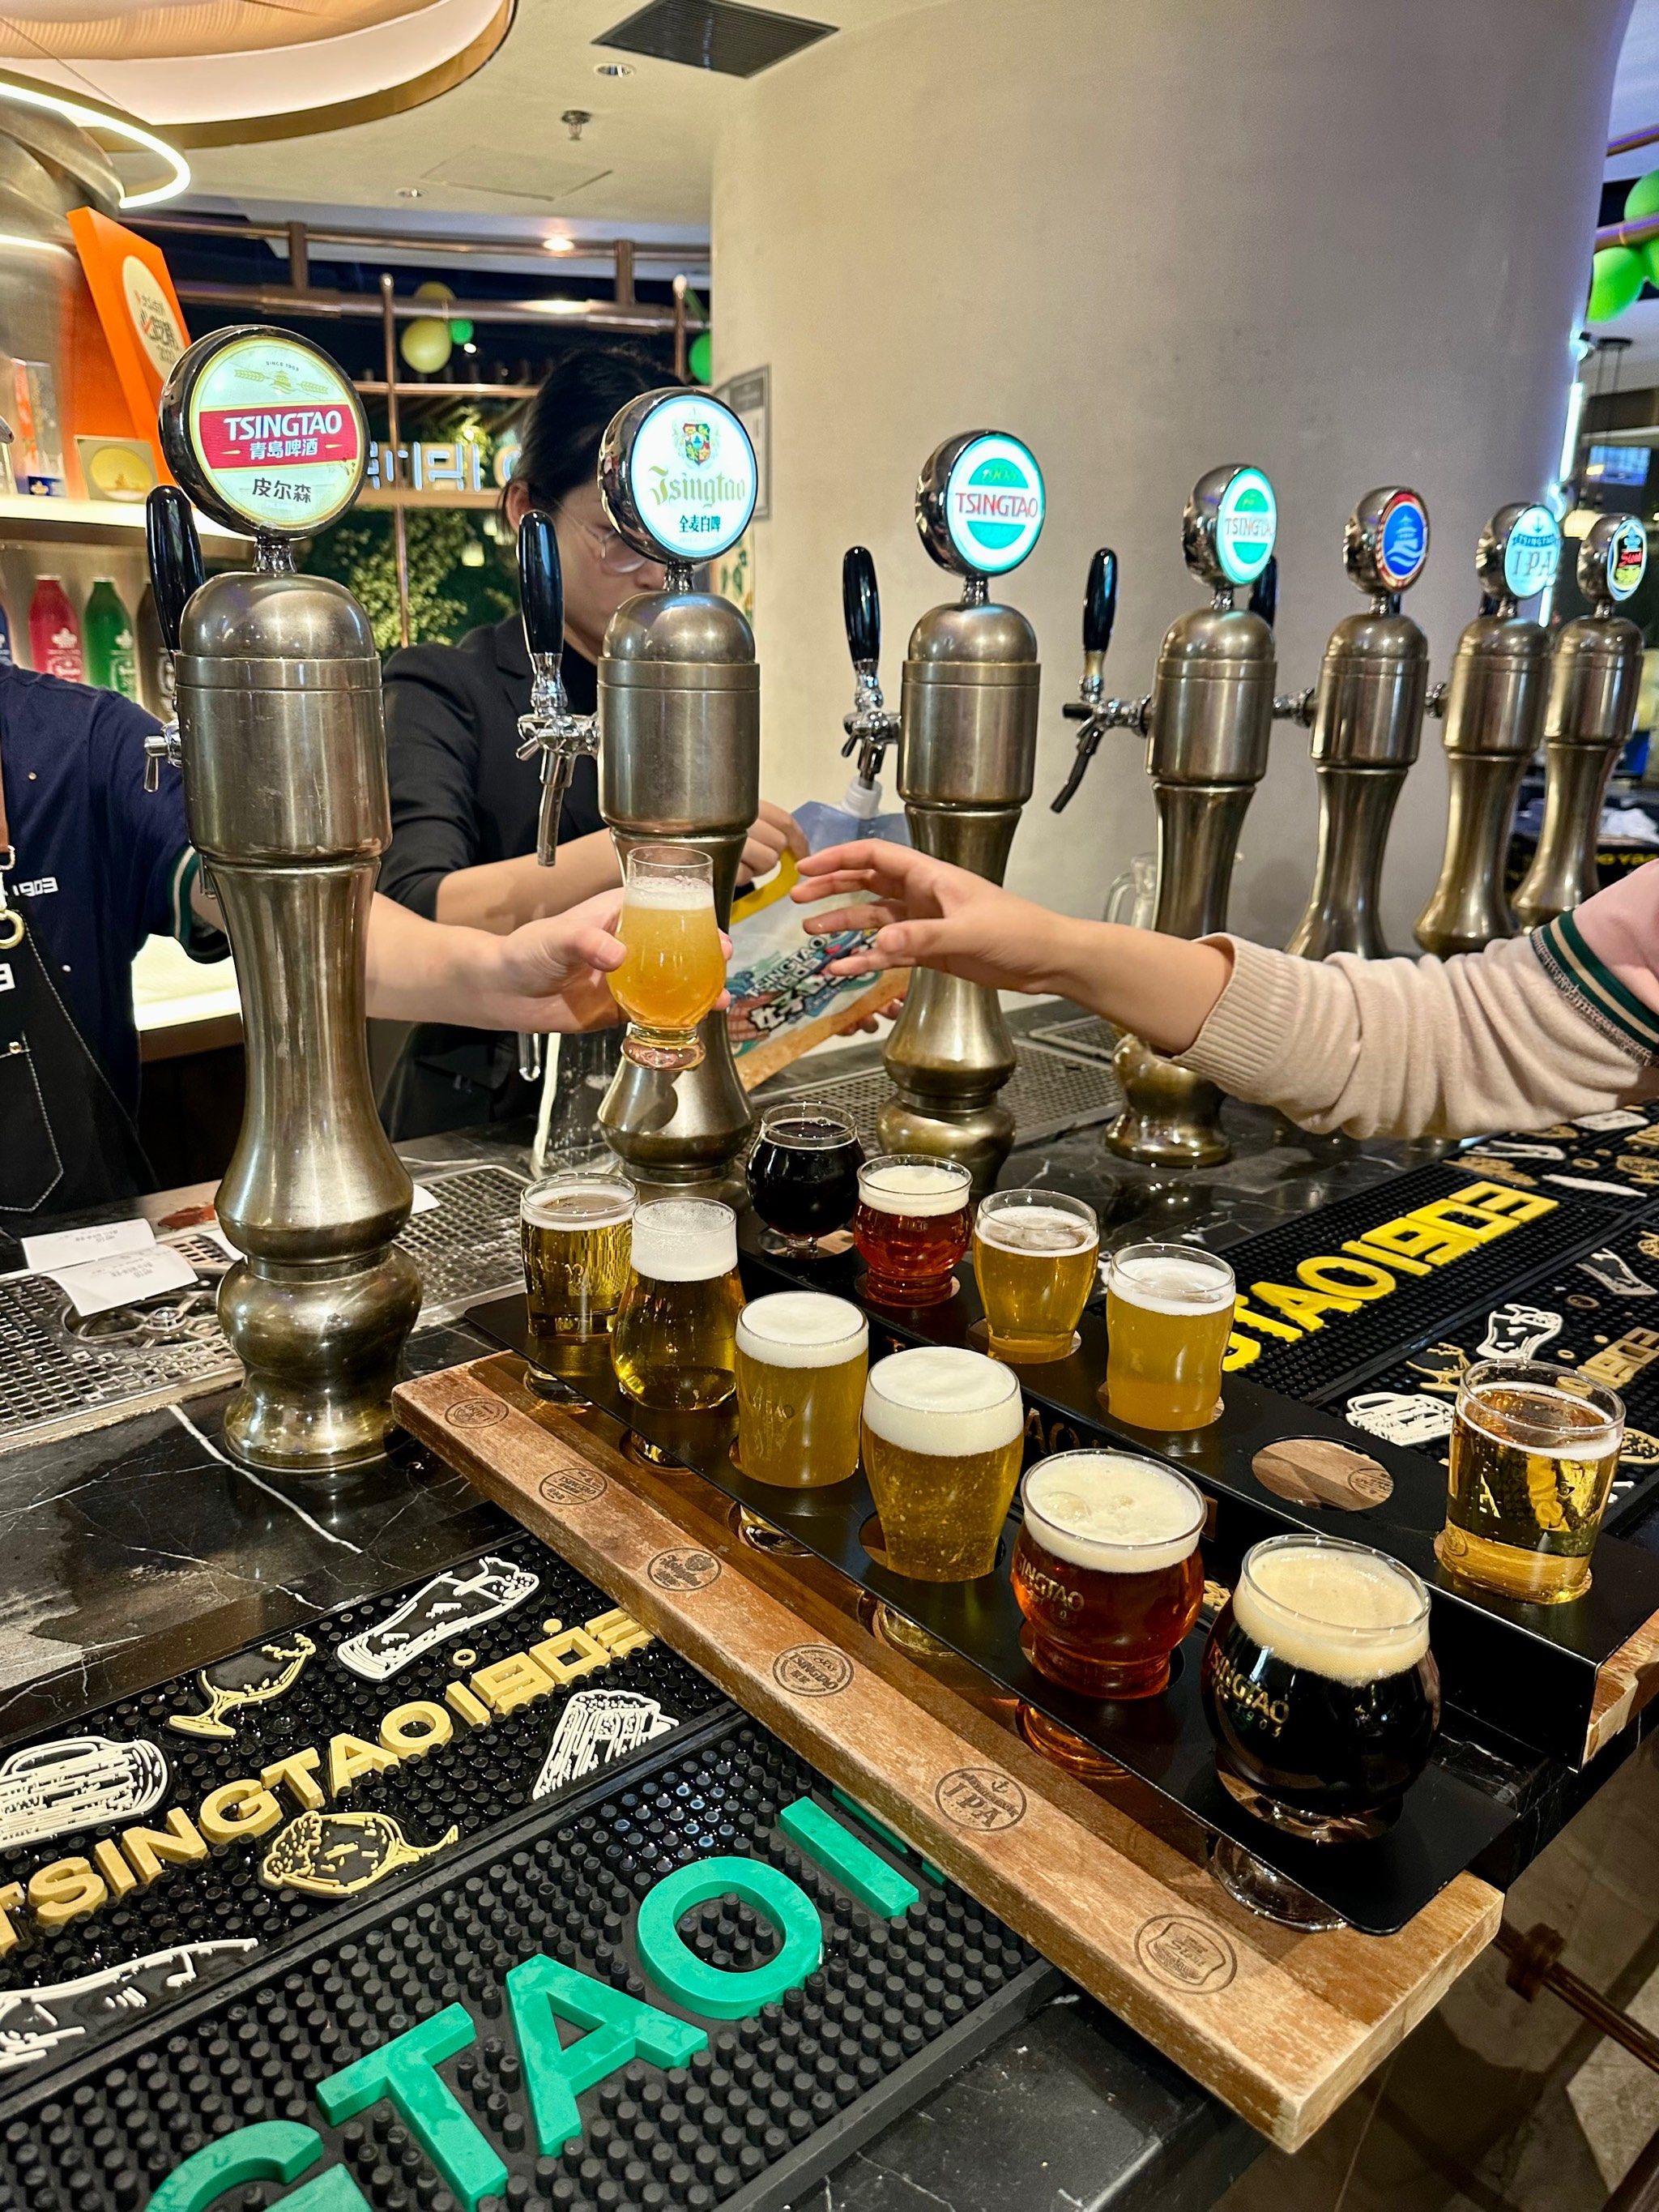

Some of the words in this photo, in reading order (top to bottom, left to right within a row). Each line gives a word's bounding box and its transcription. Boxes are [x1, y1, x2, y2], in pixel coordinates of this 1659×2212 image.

[224, 410, 343, 442] TSINGTAO
[252, 477, 311, 503] 皮尔森
[649, 465, 746, 510] Tsingtao
[955, 493, 1038, 519] TSINGTAO
[679, 515, 722, 533] 全麦白啤
[1512, 550, 1553, 577] IPA
[12, 877, 59, 897] 1903
[745, 936, 827, 998] TSINGTAO
[788, 1652, 839, 1690] TSINGTAO
[944, 1782, 1002, 1828] IPA
